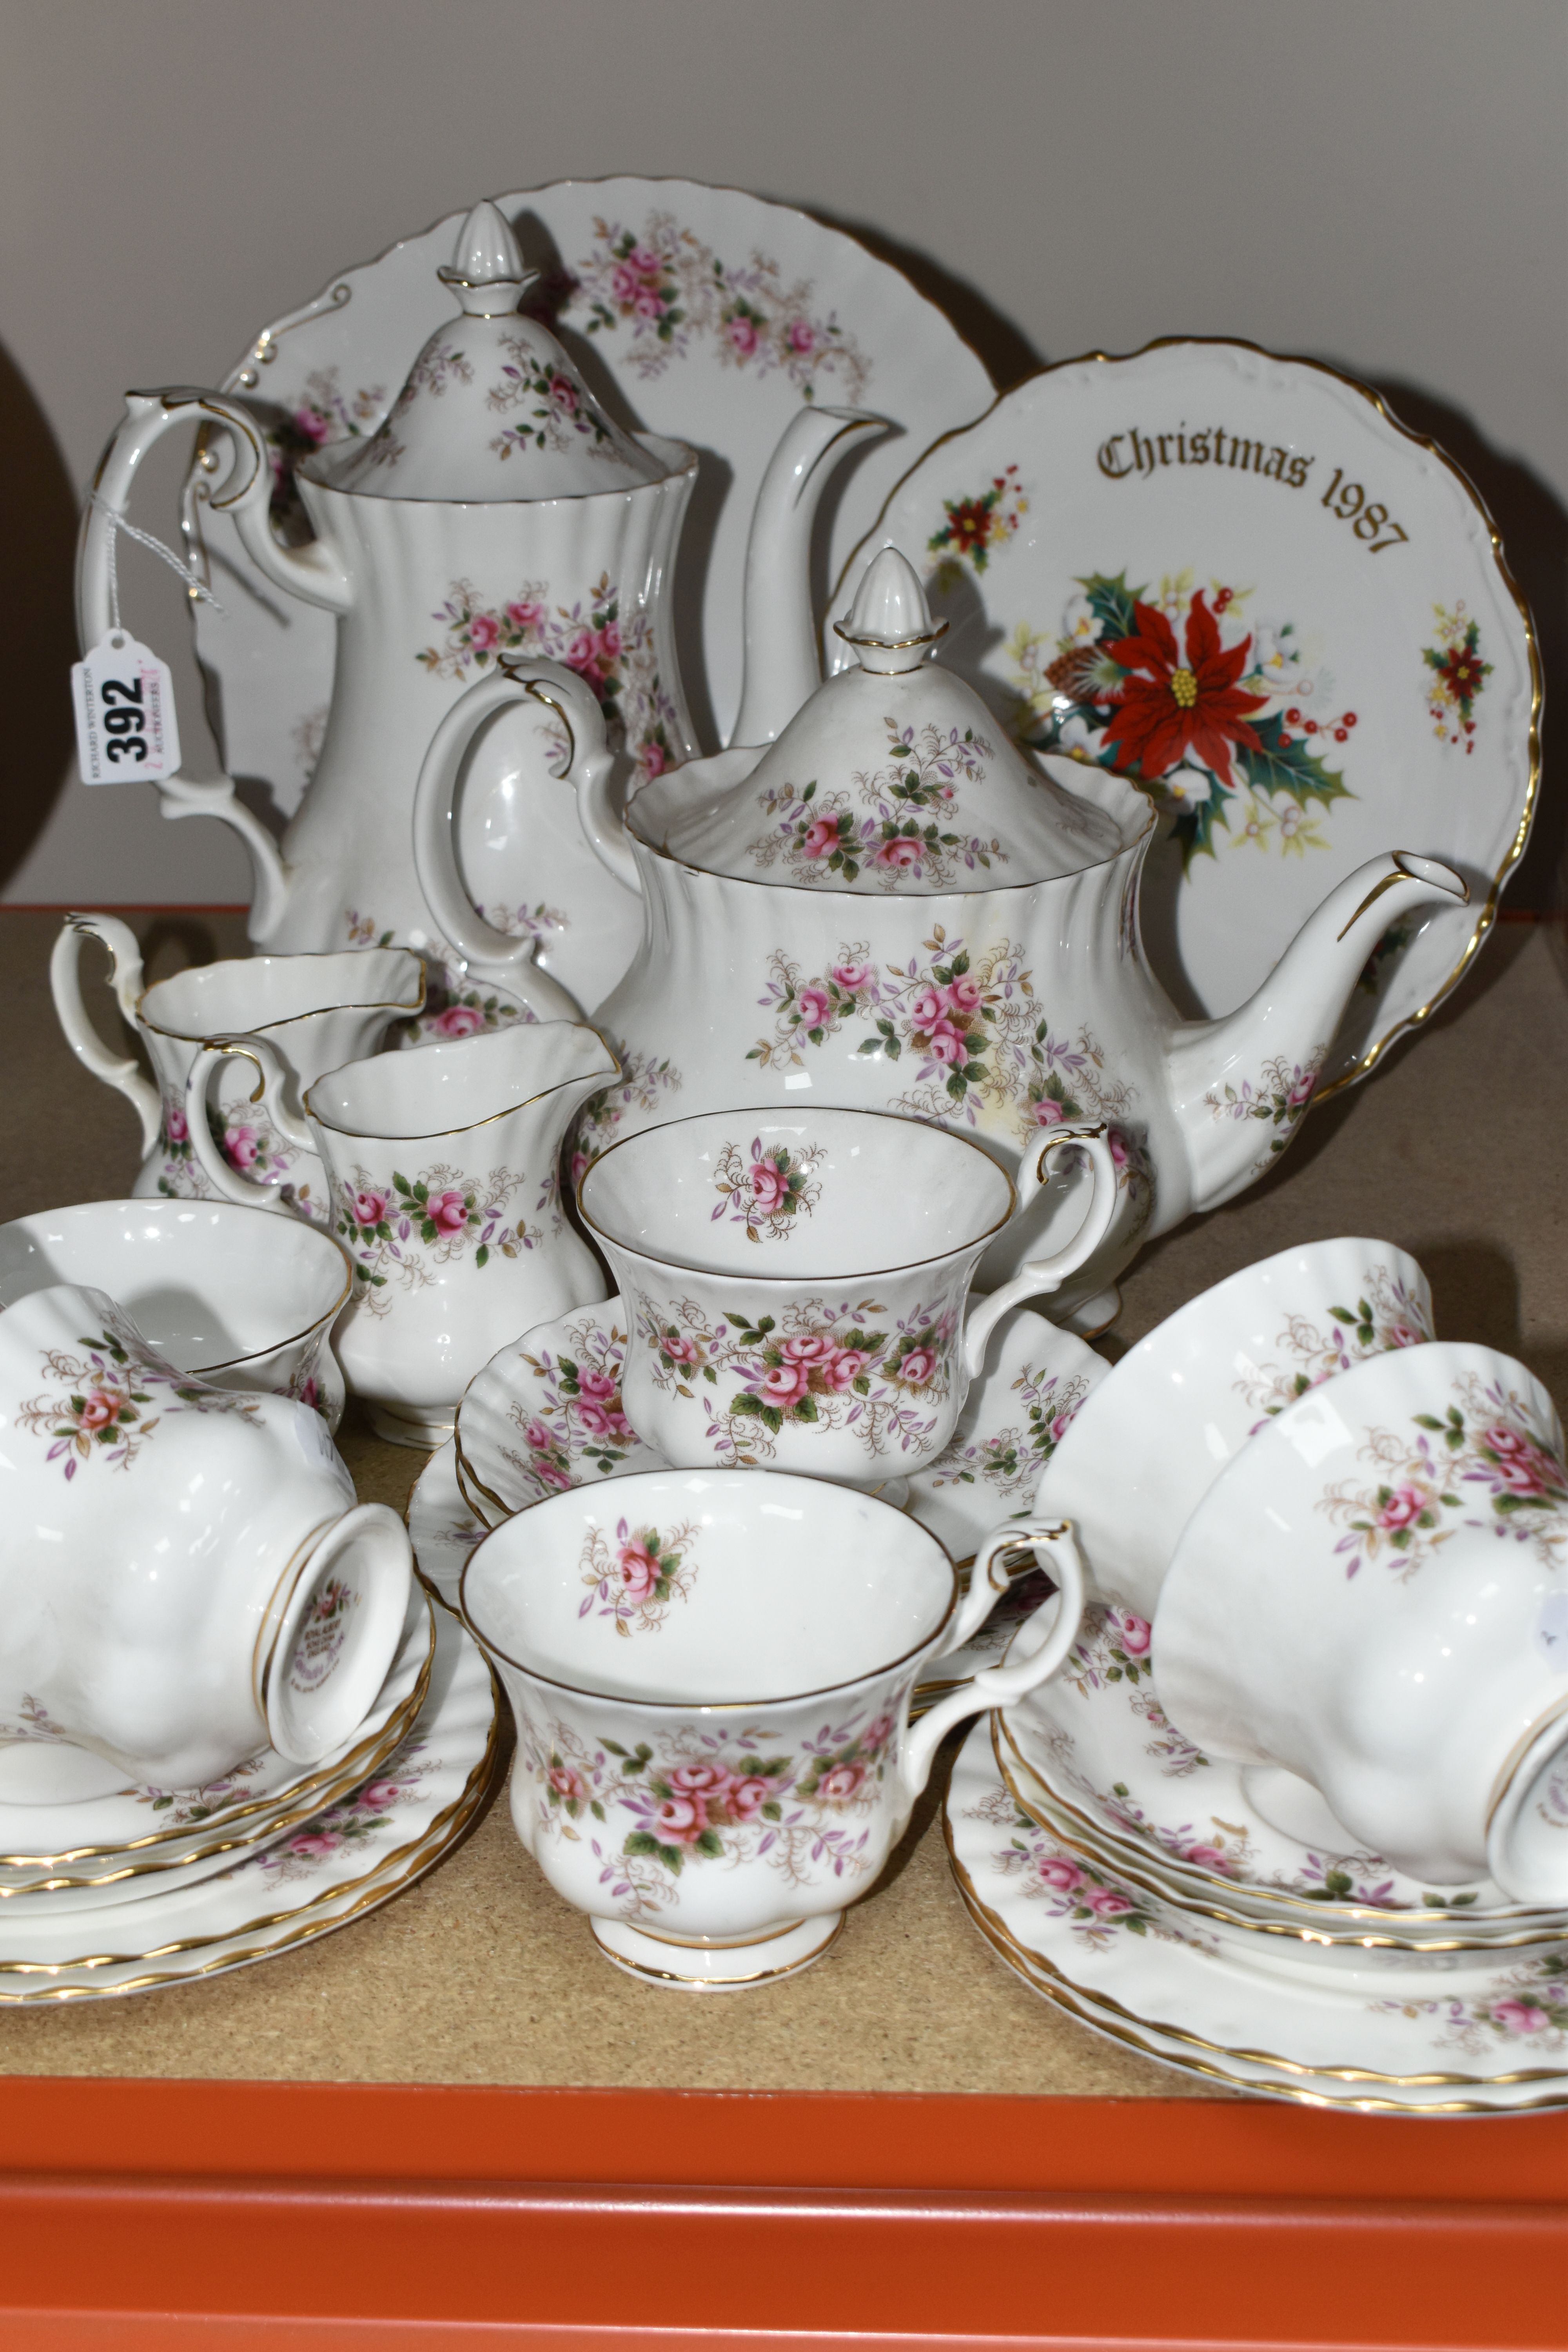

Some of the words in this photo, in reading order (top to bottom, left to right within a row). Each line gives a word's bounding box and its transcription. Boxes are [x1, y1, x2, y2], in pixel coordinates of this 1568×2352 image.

[1097, 420, 1316, 489] Christmas
[1321, 468, 1409, 554] 1987
[83, 668, 96, 730] WINTERTON
[101, 677, 148, 764] 392
[151, 683, 164, 753] AUCTIONEERS
[89, 732, 101, 779] RICHARD
